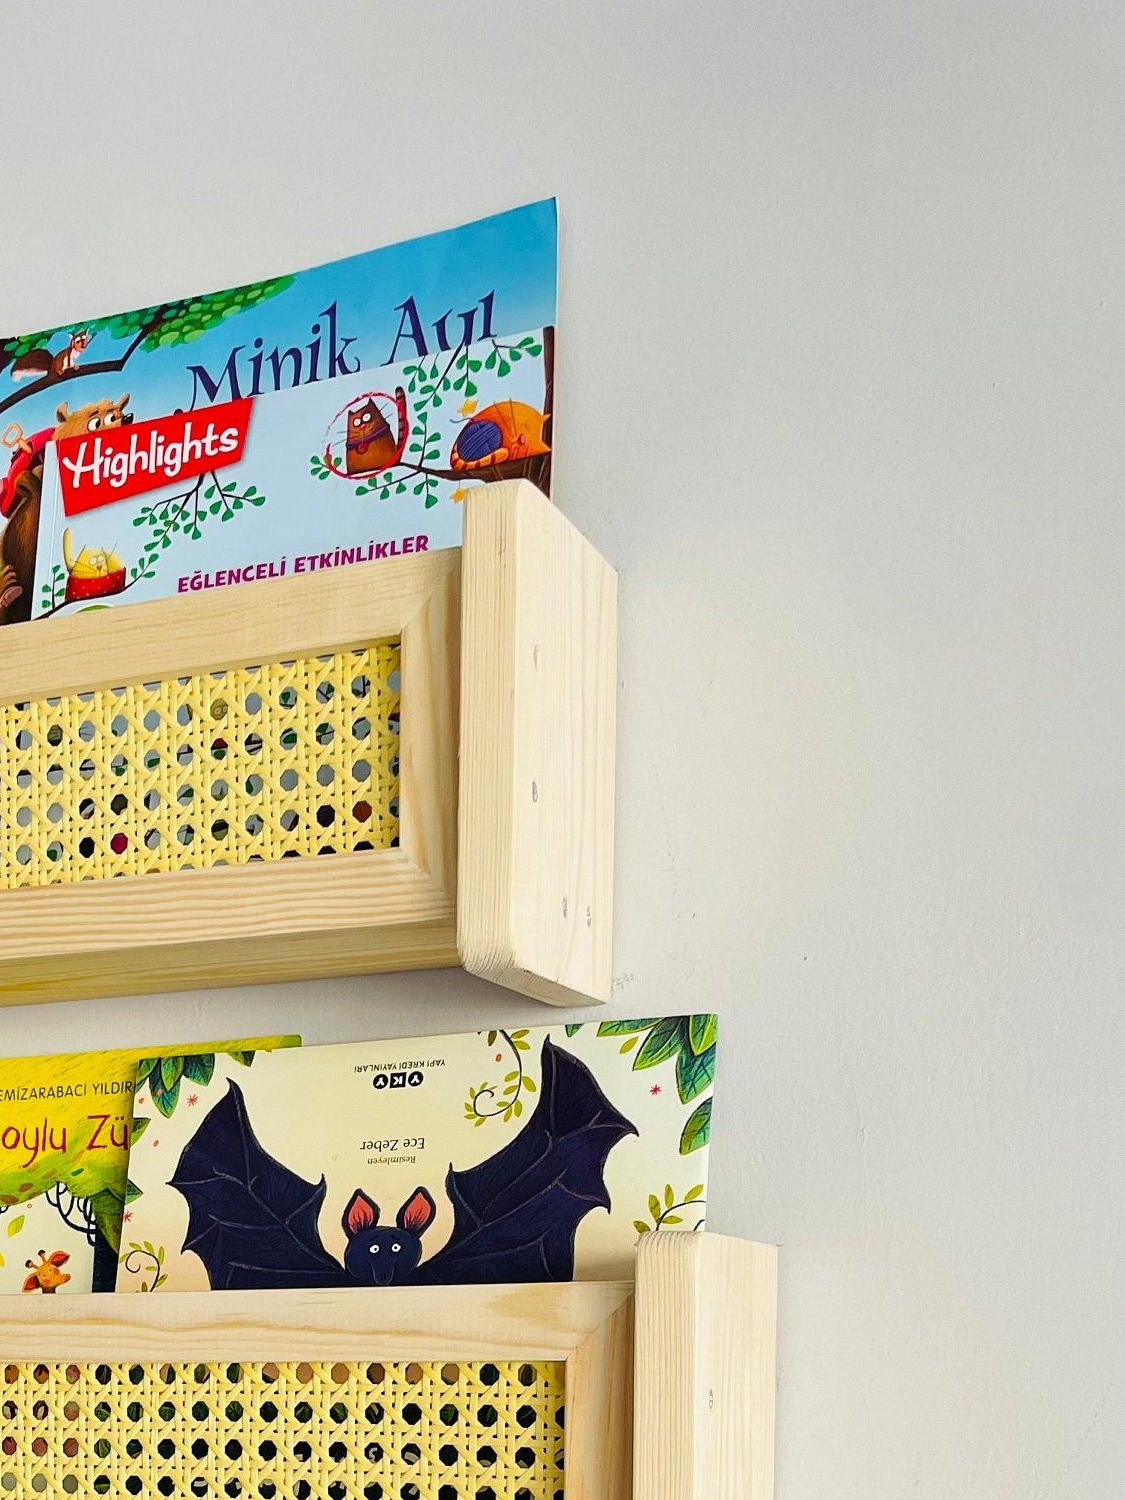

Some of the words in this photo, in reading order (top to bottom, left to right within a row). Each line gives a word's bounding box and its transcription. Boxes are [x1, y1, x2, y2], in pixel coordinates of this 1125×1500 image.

[174, 299, 361, 414] Minik
[62, 421, 240, 489] Highlights
[177, 556, 287, 593] EĞLENCELİ
[293, 535, 430, 574] ETKİNLİKLER
[92, 1080, 136, 1097] YILDIR
[373, 1071, 424, 1089] YKY
[86, 1113, 129, 1151] Zü
[359, 1139, 399, 1153] Zeber
[402, 1137, 425, 1149] Ece
[367, 1155, 417, 1166] Resimleyen
